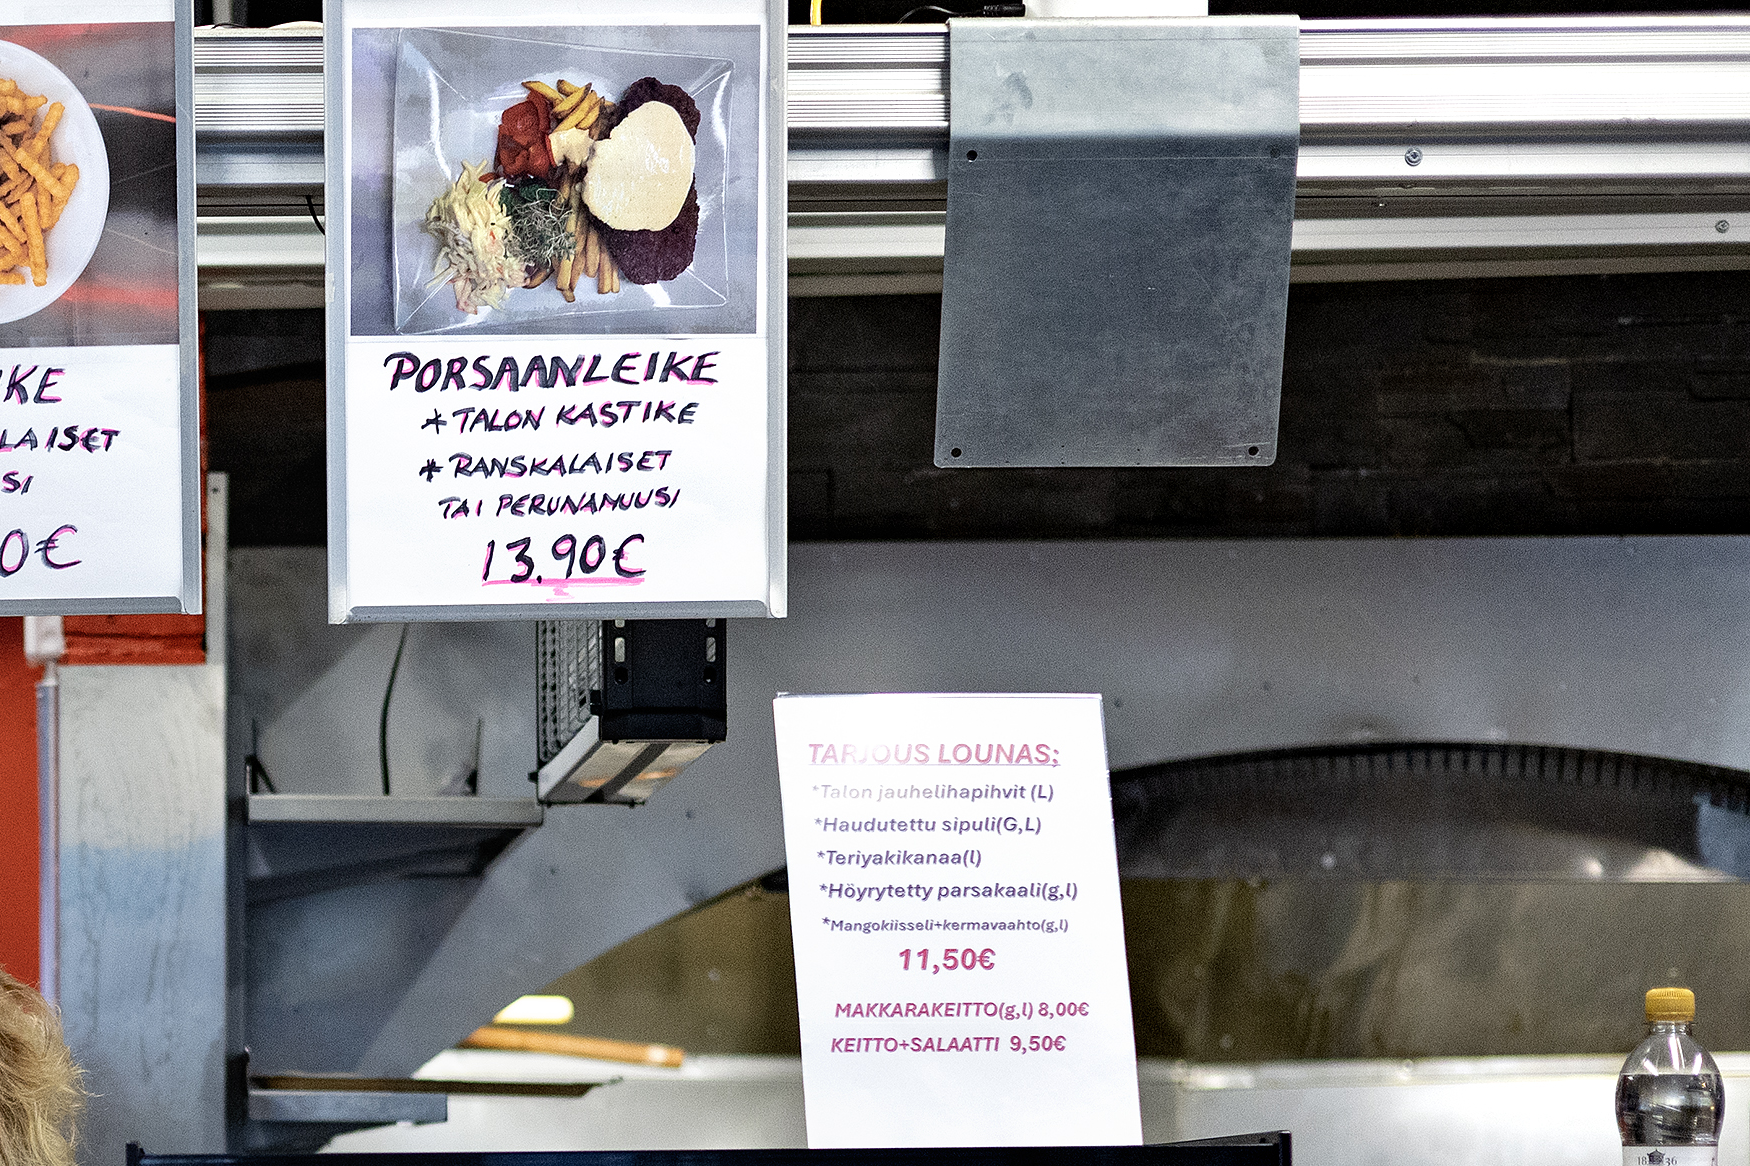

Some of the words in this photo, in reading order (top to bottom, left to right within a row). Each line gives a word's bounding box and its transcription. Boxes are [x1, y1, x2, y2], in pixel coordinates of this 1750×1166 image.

[383, 350, 721, 393] PORSAANLEIKE
[452, 406, 547, 435] TALON
[555, 400, 701, 429] KASTIKE
[448, 449, 673, 479] RANSKALAISET
[438, 496, 482, 519] TAI
[496, 486, 681, 518] PERUNAMUUSI
[481, 533, 648, 586] 13.90€
[808, 743, 931, 765] TARJOUS
[876, 784, 1027, 802] jauhelihapihvit
[1030, 784, 1054, 803] (L)
[940, 816, 1042, 835] sipuli(G,L)
[937, 882, 1078, 902] parsakaali(g,l)
[898, 948, 996, 975] 11,50€
[834, 1001, 1034, 1021] MAKKARAKEITTO(g,l)
[1038, 1001, 1090, 1020] 8,00€
[830, 1037, 1000, 1053] KEITTO+SALAATTI
[1009, 1035, 1067, 1055] 9,50€
